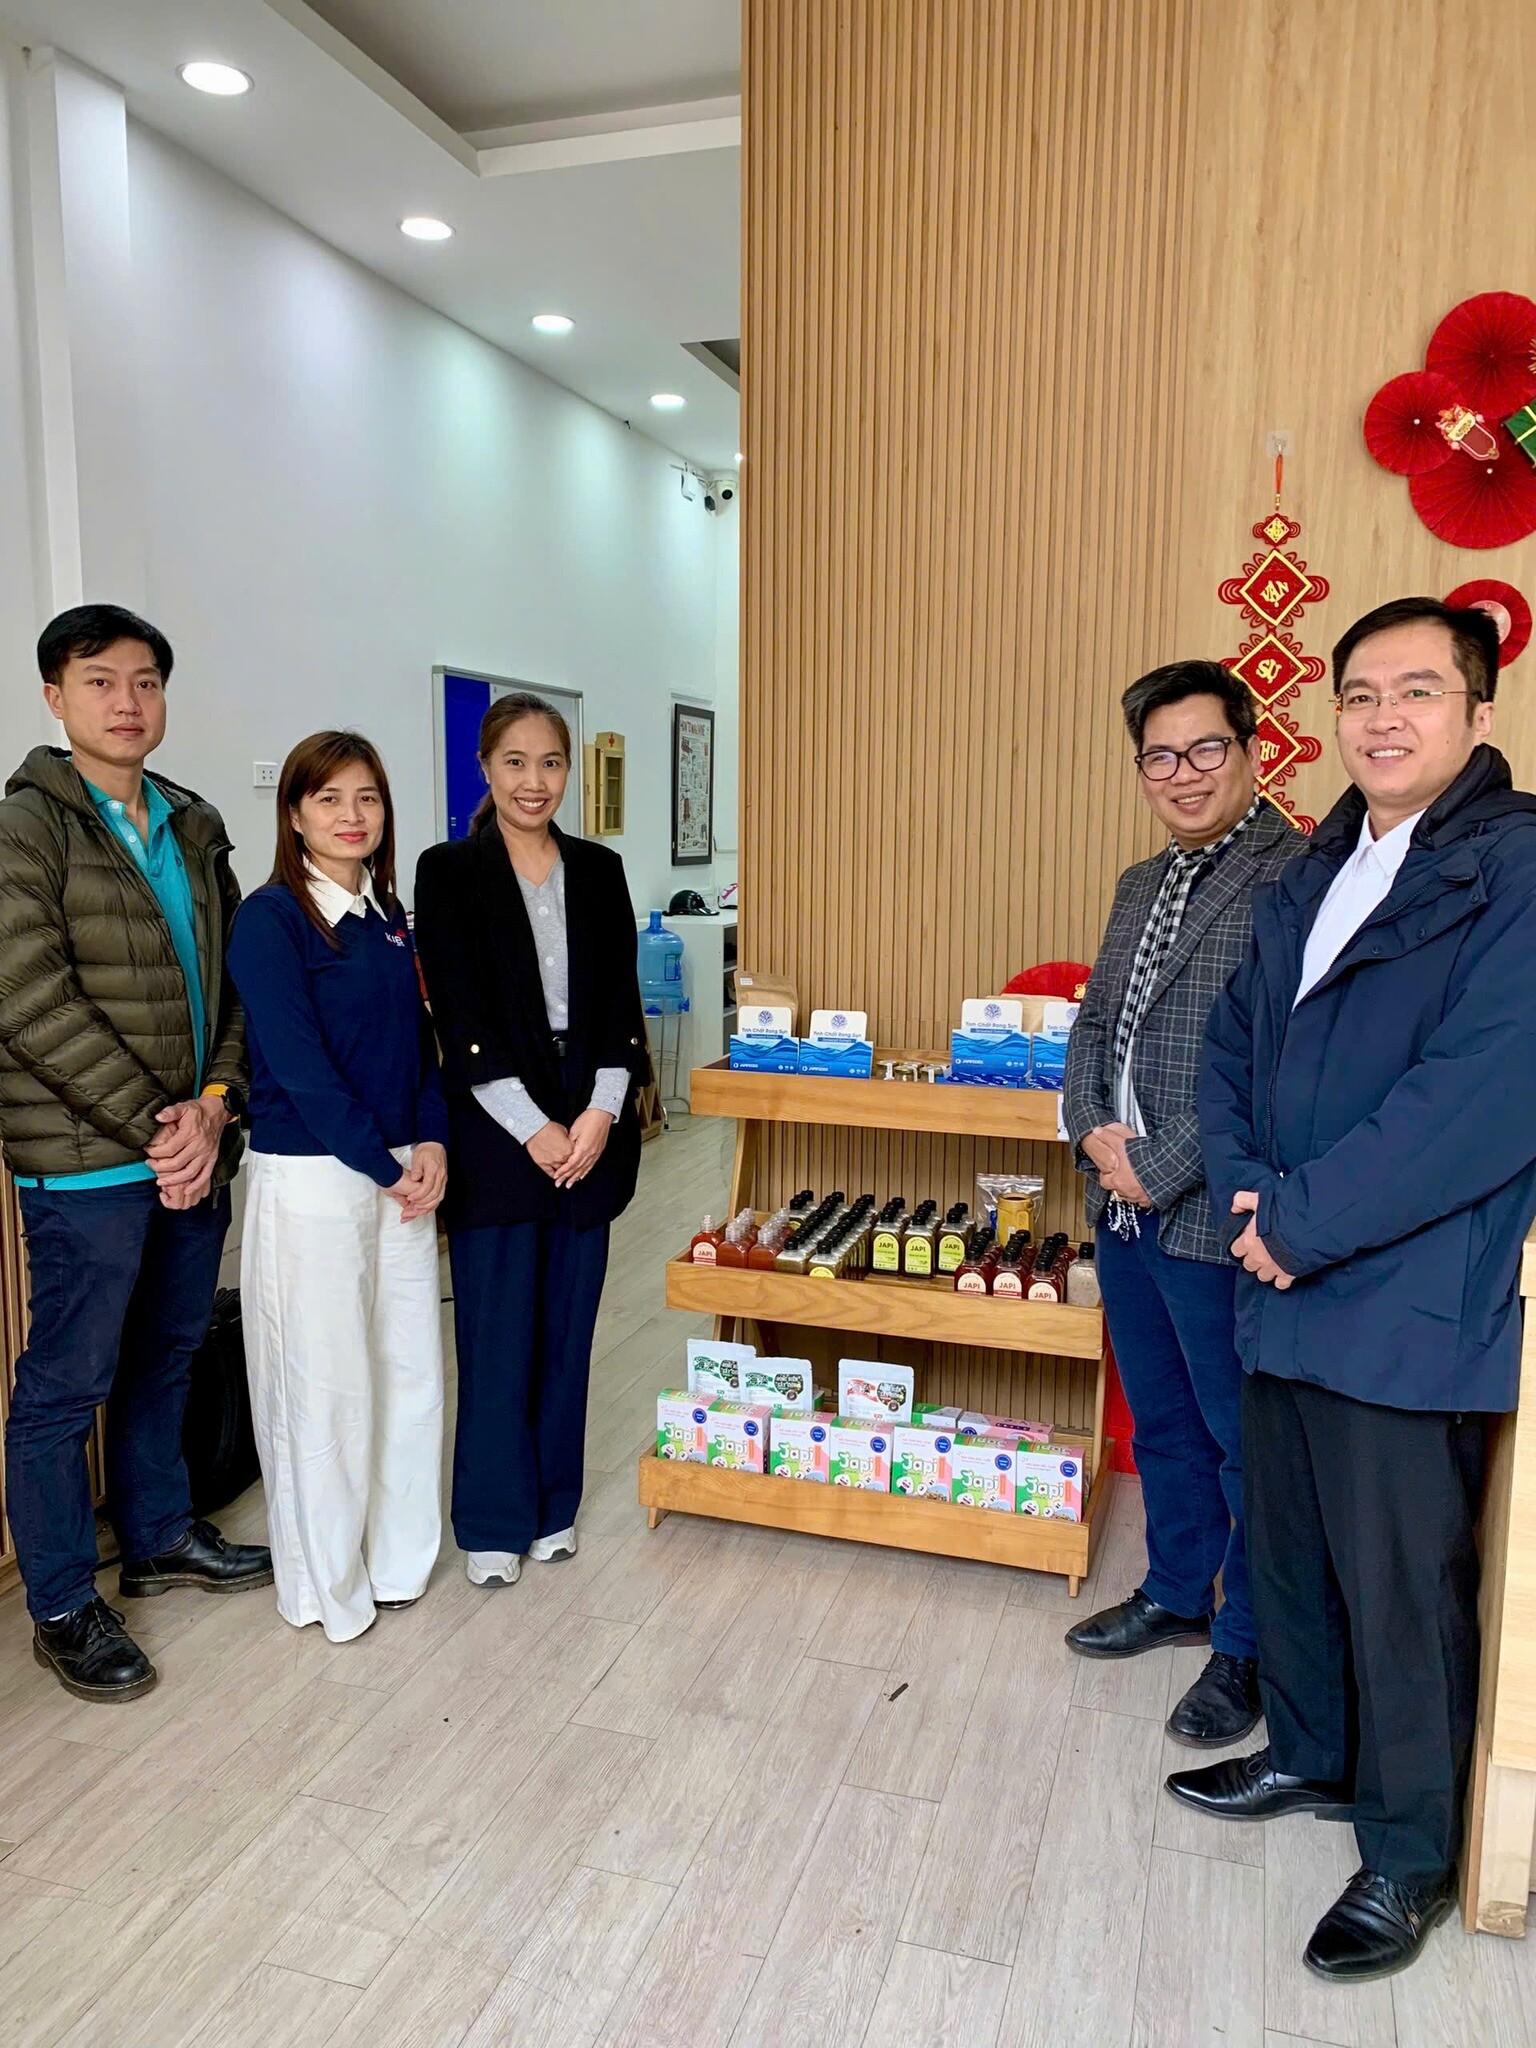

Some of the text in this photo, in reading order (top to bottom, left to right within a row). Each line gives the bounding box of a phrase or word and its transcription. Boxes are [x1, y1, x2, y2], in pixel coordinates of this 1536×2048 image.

[1260, 580, 1289, 608] VẠN
[944, 1243, 960, 1251] JAPI
[963, 1282, 981, 1290] JAPI
[999, 1282, 1016, 1290] JAPI
[664, 1421, 696, 1444] Japi
[714, 1434, 748, 1456] Japi
[778, 1442, 814, 1465] Japi
[838, 1451, 874, 1474] Japi
[901, 1452, 937, 1477] Japi
[961, 1469, 998, 1493] Japi
[1025, 1476, 1065, 1500] Japi
